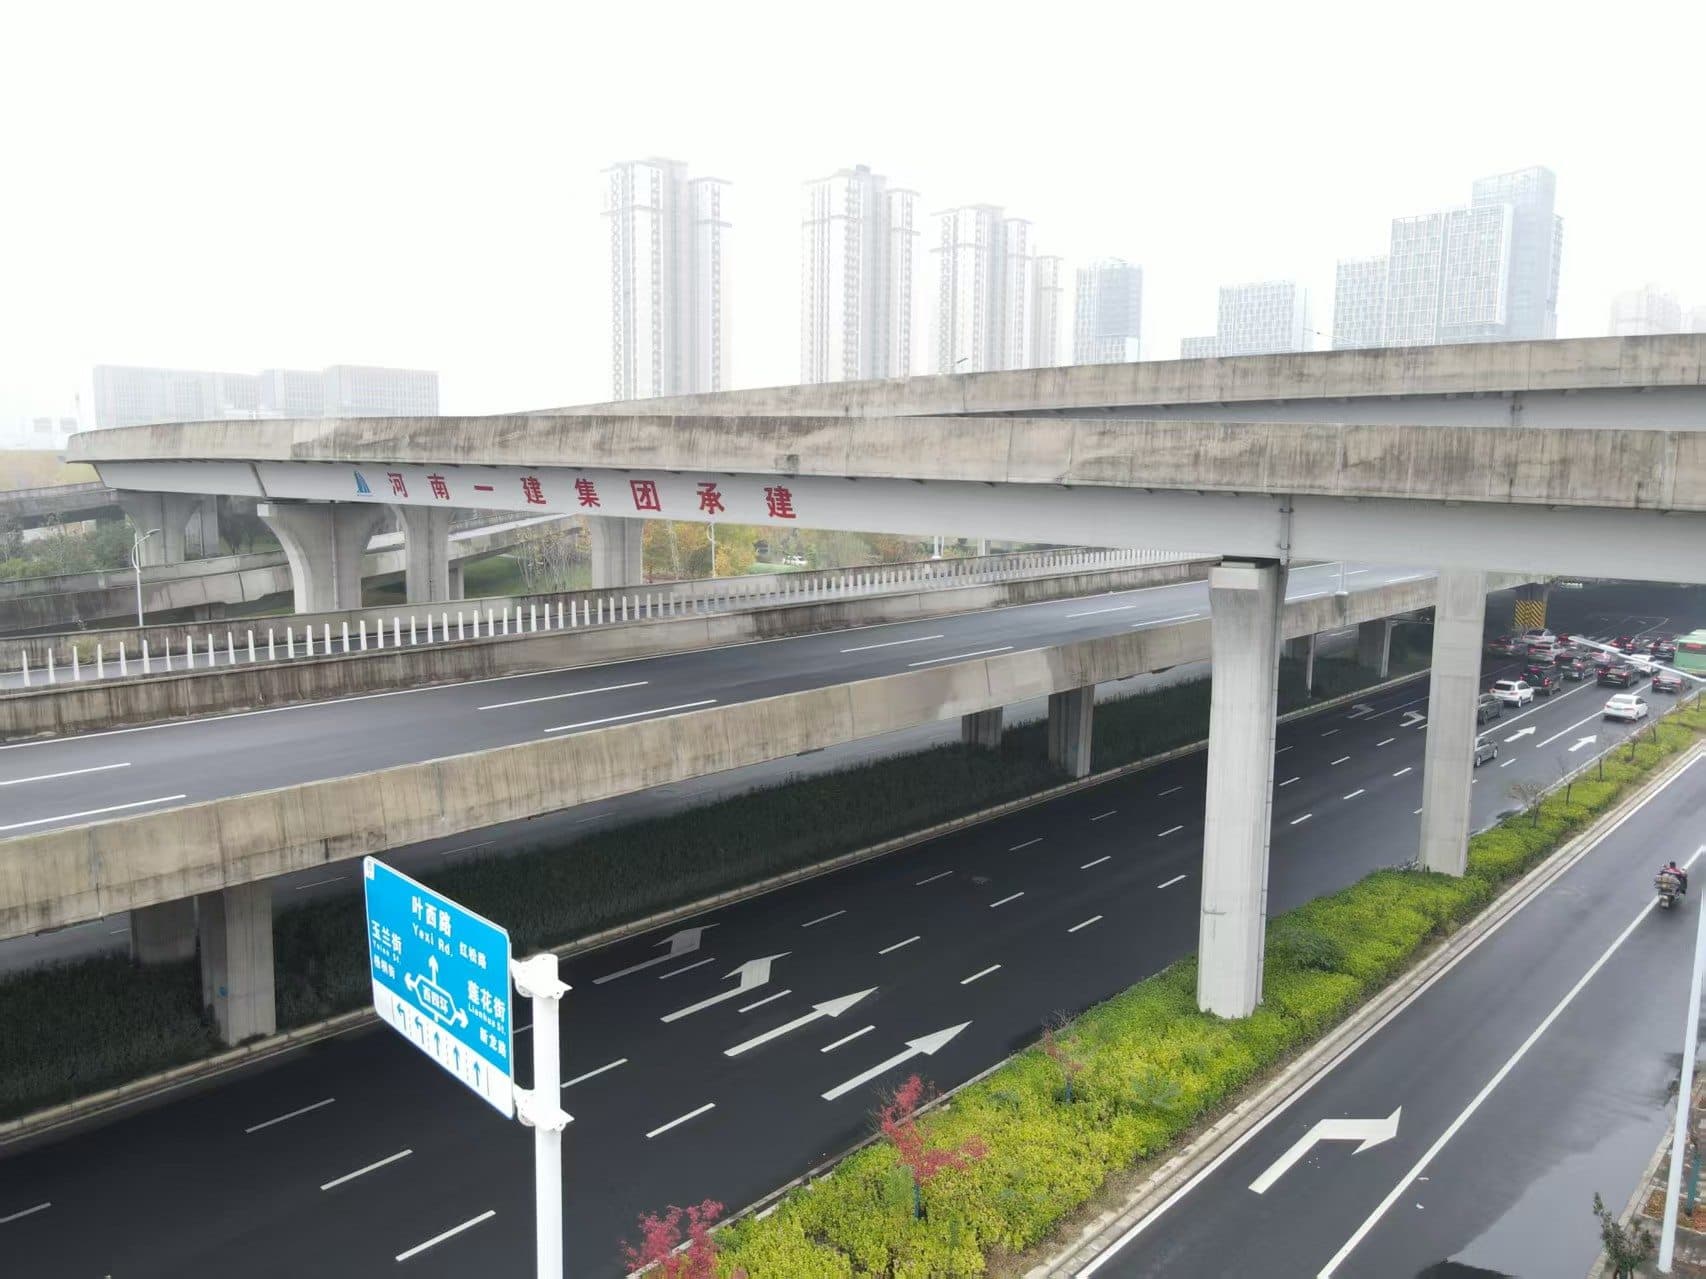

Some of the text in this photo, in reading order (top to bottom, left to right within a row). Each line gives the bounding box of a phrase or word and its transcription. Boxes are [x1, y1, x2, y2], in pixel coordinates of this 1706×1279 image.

[386, 472, 797, 520] 河南一建集团承建
[371, 919, 402, 955] 玉兰街
[411, 895, 452, 938] 叶西路
[412, 922, 435, 946] Yexi
[467, 979, 506, 1023] 莲花街
